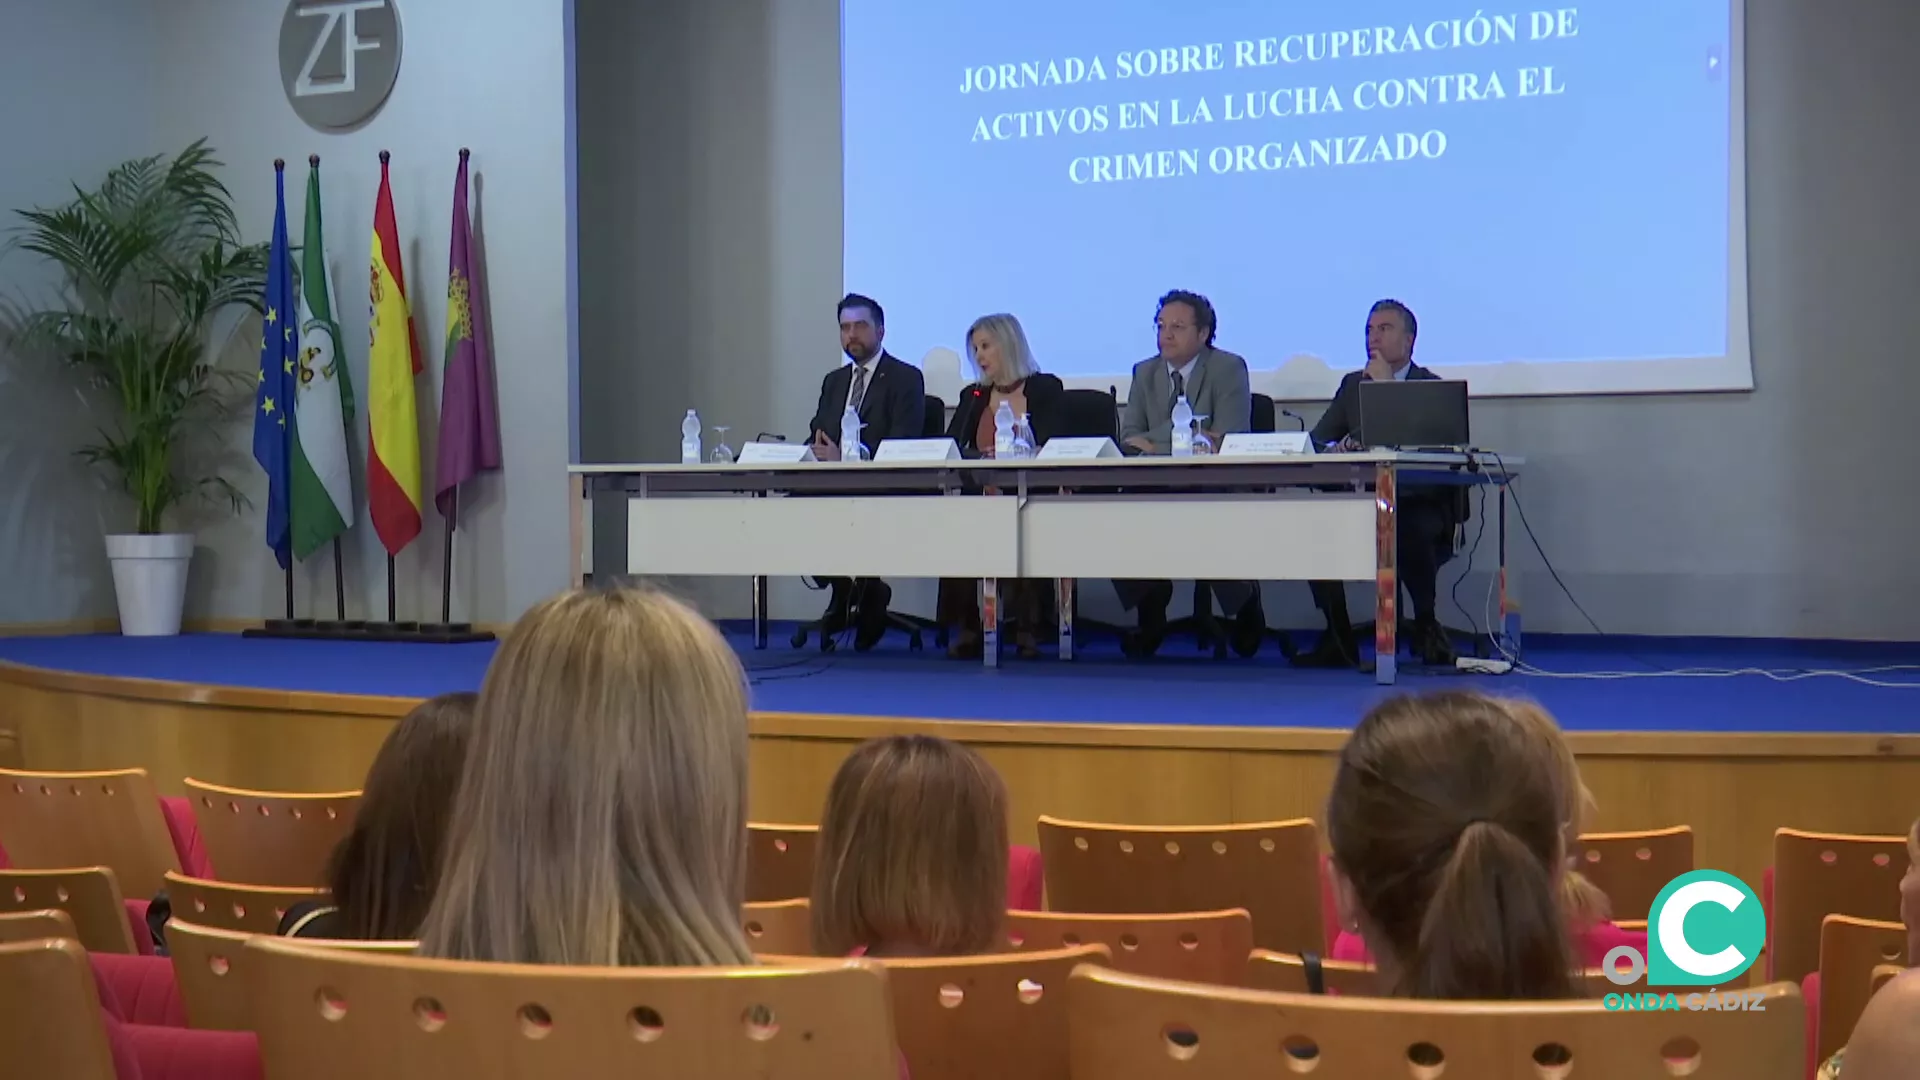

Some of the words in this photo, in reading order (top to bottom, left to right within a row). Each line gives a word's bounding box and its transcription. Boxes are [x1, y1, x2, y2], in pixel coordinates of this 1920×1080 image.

[295, 0, 385, 96] ZF
[959, 55, 1107, 94] JORNADA
[1116, 42, 1224, 79] SOBRE
[1234, 9, 1517, 69] RECUPERACIÓN
[1529, 7, 1579, 41] DE
[971, 104, 1109, 142] ACTIVOS
[1118, 100, 1160, 130] EN
[1170, 96, 1214, 126] LA
[1224, 85, 1344, 121] LUCHA
[1352, 70, 1506, 111] CONTRA
[1518, 66, 1566, 97] EL
[1068, 148, 1199, 185] CRIMEN
[1208, 129, 1447, 174] ORGANIZADO
